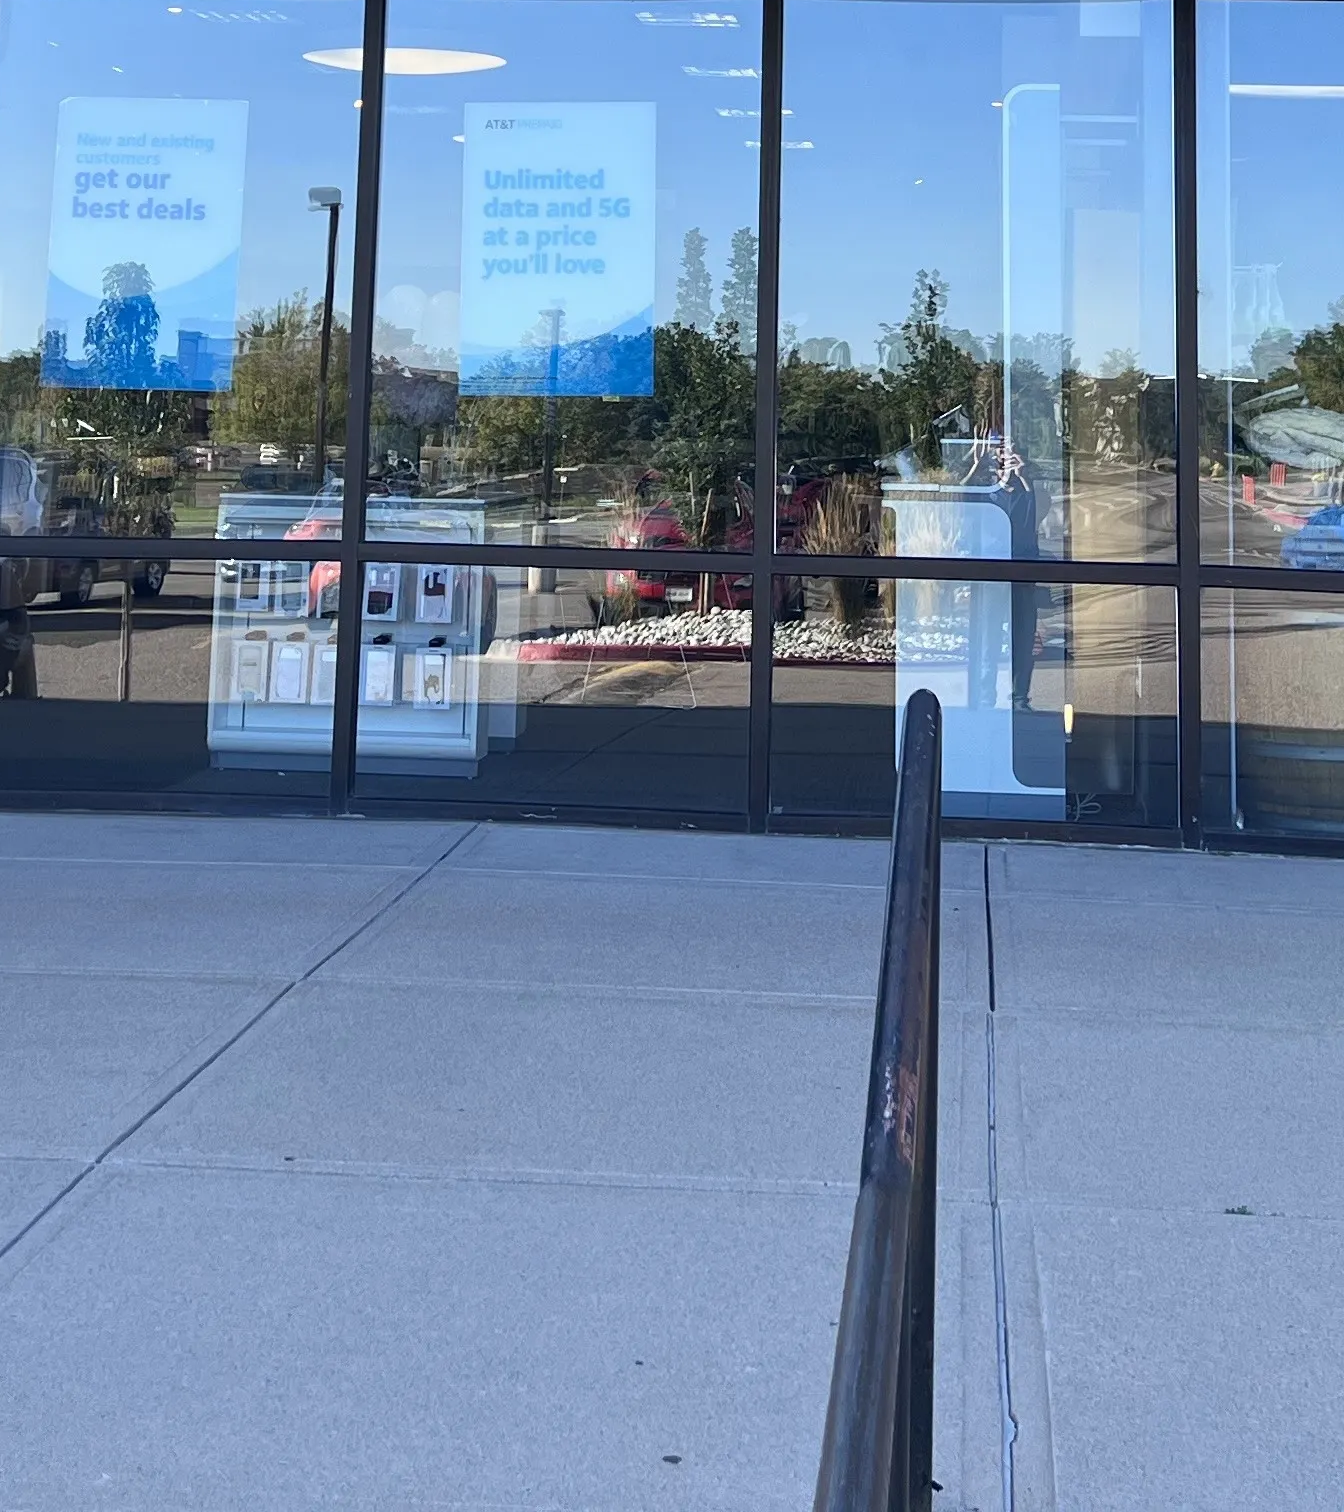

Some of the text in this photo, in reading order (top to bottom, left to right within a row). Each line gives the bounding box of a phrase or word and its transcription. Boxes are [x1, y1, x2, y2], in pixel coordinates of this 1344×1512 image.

[485, 119, 515, 130] AT&T
[77, 132, 215, 152] New and existing
[76, 152, 161, 165] customers
[74, 169, 172, 194] get our
[484, 168, 605, 190] Unlimited
[72, 196, 207, 221] best deals
[483, 197, 631, 219] data and 5G
[483, 224, 597, 251] at a price
[481, 253, 606, 280] you'll love
